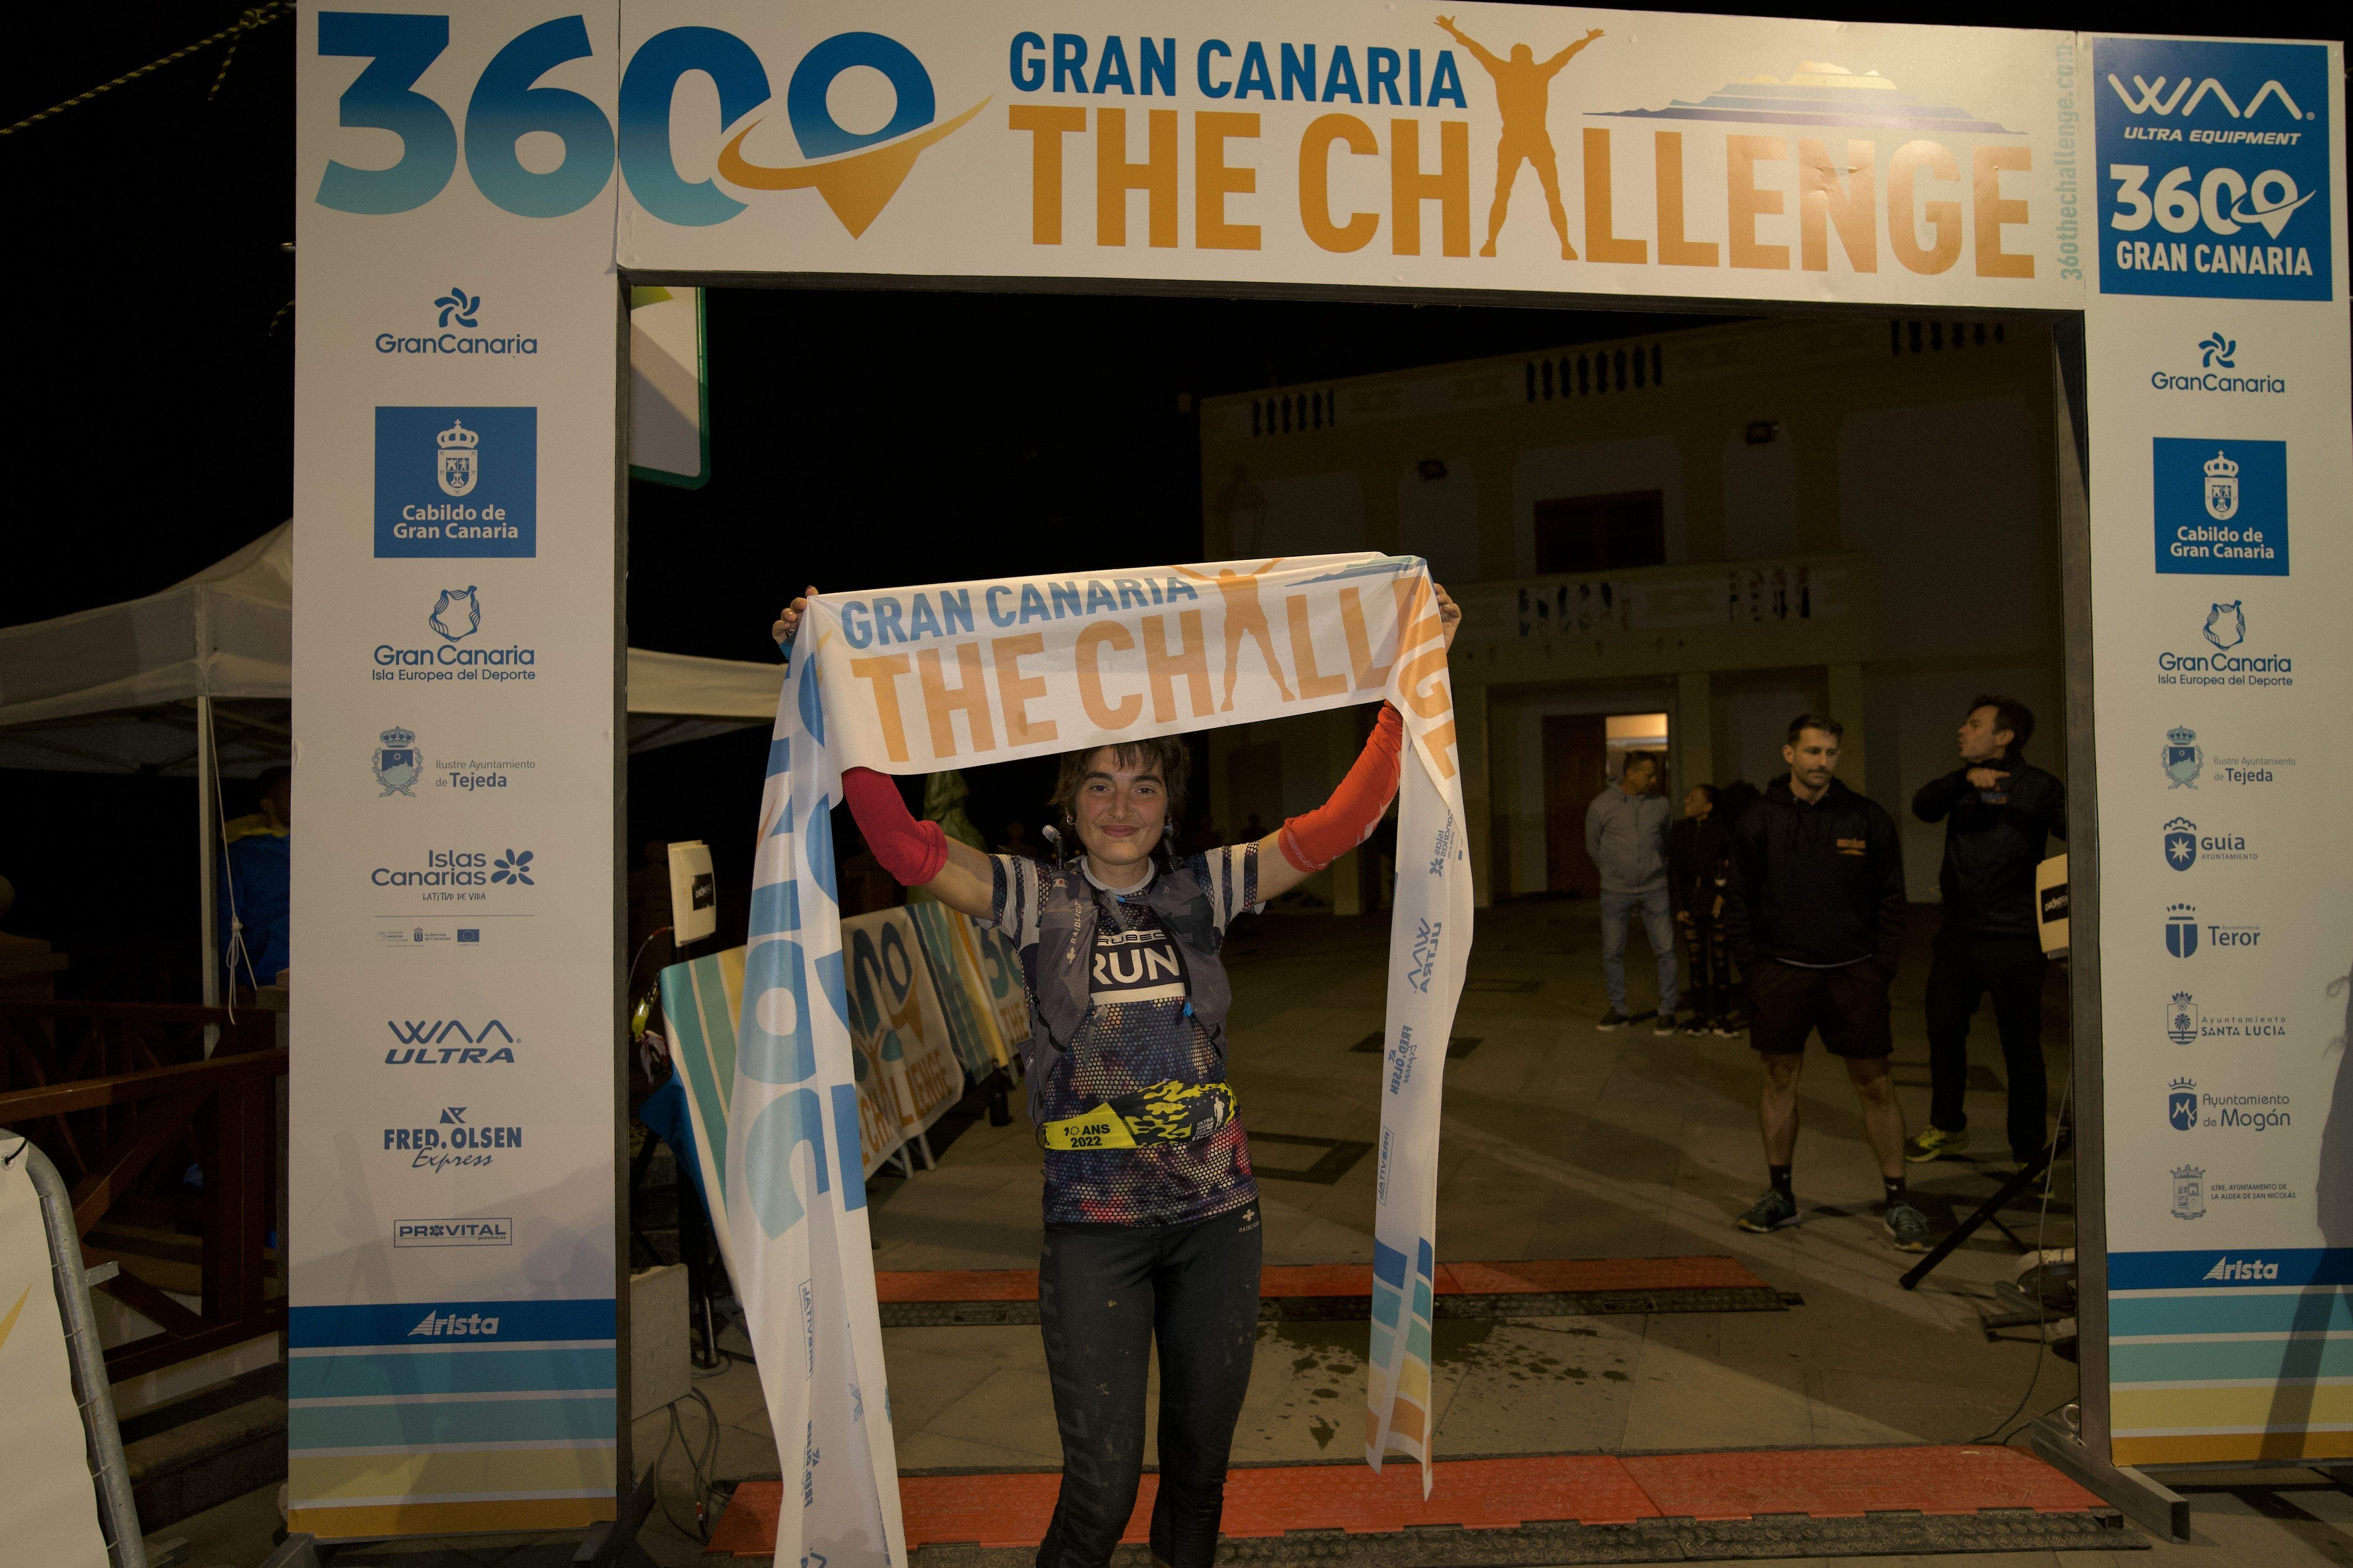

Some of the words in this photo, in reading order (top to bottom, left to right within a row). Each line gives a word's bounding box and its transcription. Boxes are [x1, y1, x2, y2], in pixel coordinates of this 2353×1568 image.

[1010, 31, 1176, 97] GRAN
[1198, 39, 1468, 108] CANARIA
[2124, 126, 2182, 142] ULTRA
[2189, 130, 2301, 145] EQUIPMENT
[1009, 105, 1261, 250] THE
[2117, 241, 2187, 271] GRAN
[2195, 244, 2313, 276] CANARIA
[402, 505, 476, 521] Cabildo
[482, 504, 506, 521] de
[394, 523, 439, 538] Gran
[445, 523, 518, 538] Canaria
[2177, 526, 2239, 542] Cabildo
[2243, 527, 2263, 542] de
[2170, 543, 2209, 558] Gran
[2213, 543, 2274, 559] Canaria
[841, 588, 974, 649] GRAN
[986, 577, 1199, 628] CANARIA
[374, 645, 434, 665] Gran
[437, 645, 535, 666] Canaria
[2159, 652, 2208, 671] Gran
[2211, 653, 2291, 672] Canaria
[372, 669, 394, 680] Isla
[399, 669, 453, 682] Europea
[457, 669, 477, 680] del
[482, 669, 536, 682] Deporte
[2158, 674, 2176, 684] Isla
[2180, 674, 2224, 686] Europea
[2228, 675, 2245, 684] del
[2249, 676, 2293, 687] Deporte
[850, 632, 1058, 762] THE
[436, 760, 466, 769] Ilustre
[469, 760, 535, 771] Ayuntamiento
[2214, 757, 2239, 765] Ilustre
[2241, 757, 2295, 767] Ayuntamiento
[436, 778, 447, 787] de
[449, 773, 507, 791] Tejeda
[2214, 772, 2224, 781] de
[2225, 768, 2273, 785] Tejeda
[429, 850, 486, 868] Islas
[372, 865, 486, 886] Canarias
[423, 892, 454, 901] LATITUD
[1070, 900, 1082, 944] RAIDLIGHT
[2207, 926, 2260, 946] Teror
[2202, 1026, 2240, 1036] SANTA
[2246, 1026, 2285, 1036] LUCIA
[384, 1047, 515, 1065] ULTRA
[2203, 1093, 2290, 1108] Ayuntamiento
[1197, 1116, 1214, 1126] ULTRA
[2203, 1117, 2216, 1127] de
[2221, 1109, 2290, 1131] Mogán
[451, 1127, 522, 1149] OLSEN
[1082, 1124, 1110, 1135] ANS
[1071, 1136, 1102, 1148] 2022
[411, 1146, 494, 1173] Express
[2267, 1190, 2296, 1199] NICOLÁS
[2203, 1256, 2279, 1281] Arista
[407, 1309, 499, 1336] Arista
